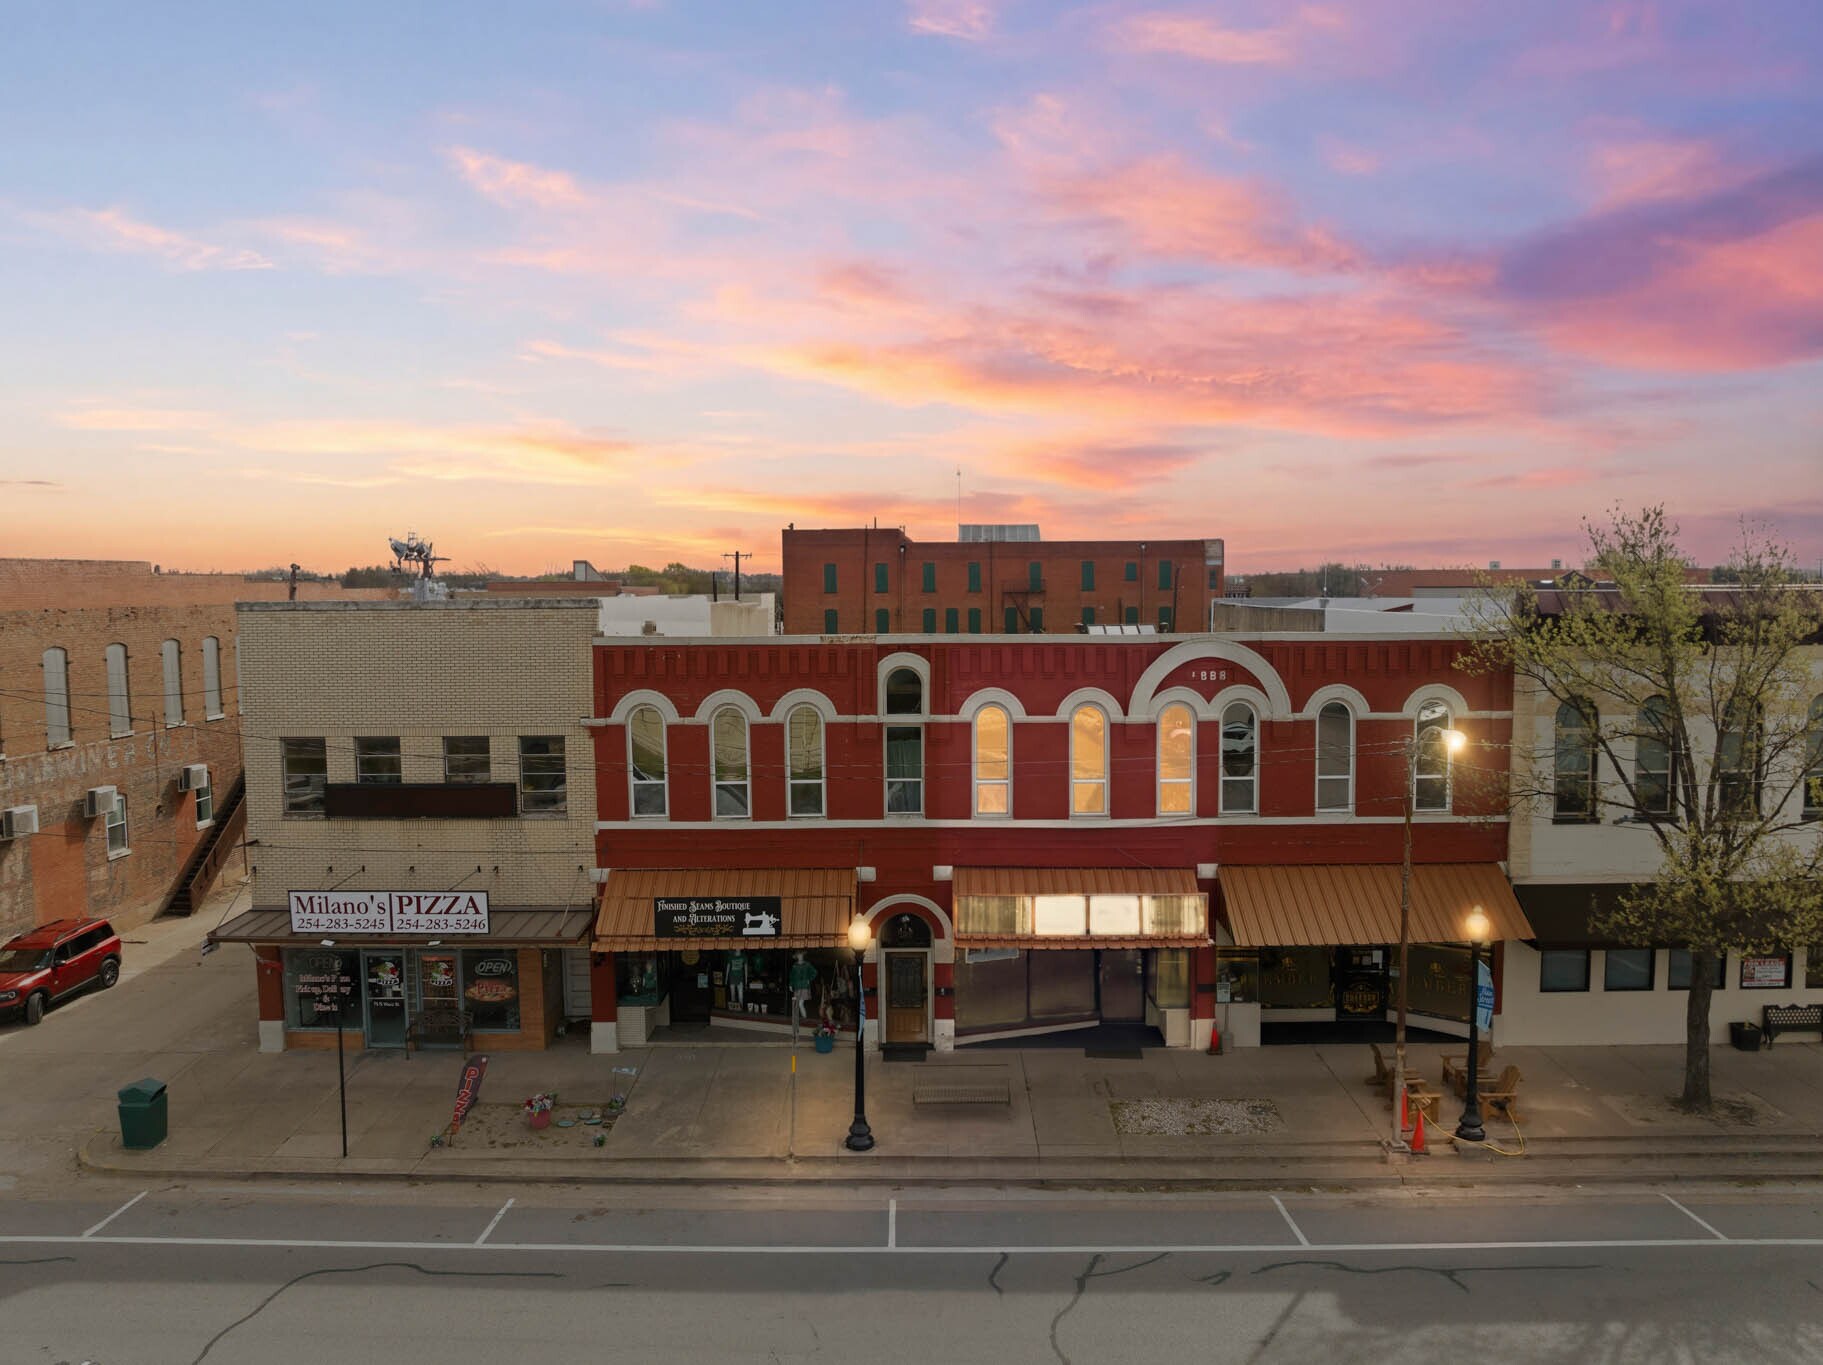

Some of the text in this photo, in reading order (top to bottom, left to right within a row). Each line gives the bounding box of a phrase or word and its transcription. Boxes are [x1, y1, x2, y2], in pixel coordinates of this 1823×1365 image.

[1191, 670, 1226, 681] 1888
[294, 894, 386, 915] Milano's
[396, 895, 483, 915] PIZZA
[297, 918, 385, 930] 254-283-5245
[396, 918, 486, 930] 254-283-5246
[478, 960, 509, 973] OPEN
[329, 974, 351, 983] Pzza
